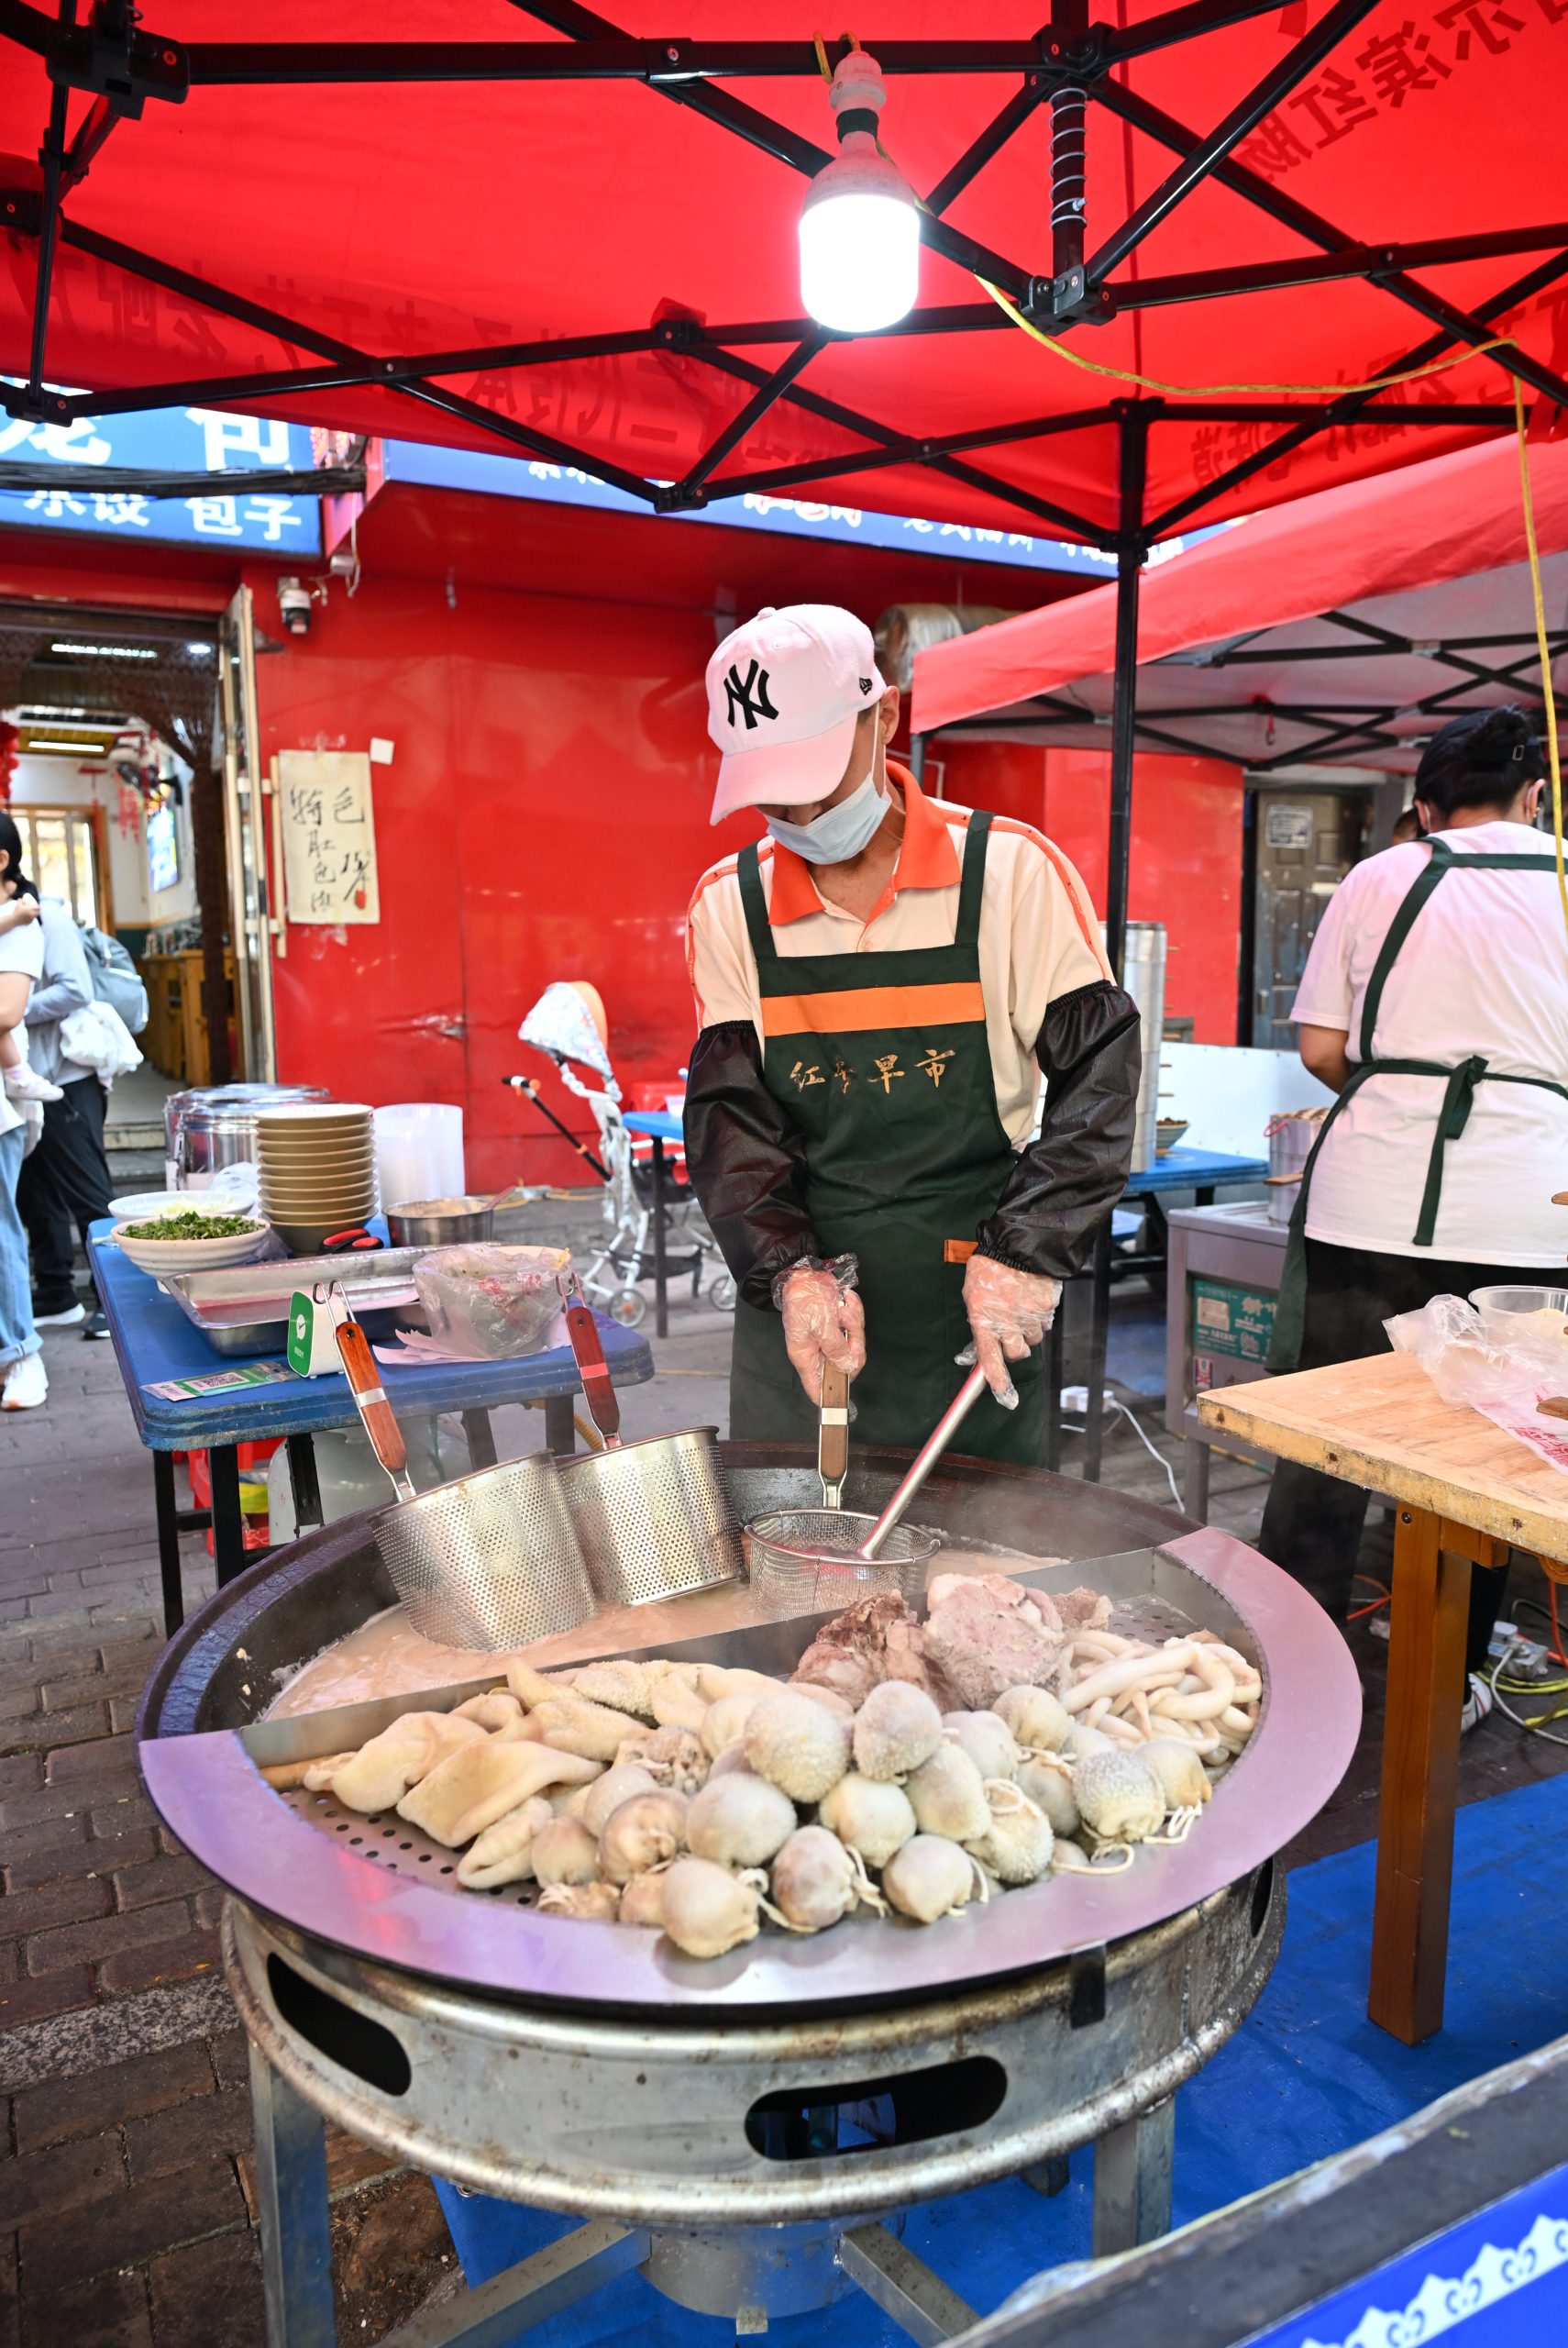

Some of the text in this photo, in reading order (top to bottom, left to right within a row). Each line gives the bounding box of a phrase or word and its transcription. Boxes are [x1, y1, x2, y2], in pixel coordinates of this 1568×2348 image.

[185, 495, 302, 541] 包子
[723, 659, 779, 730] NY
[289, 784, 365, 826] 特色
